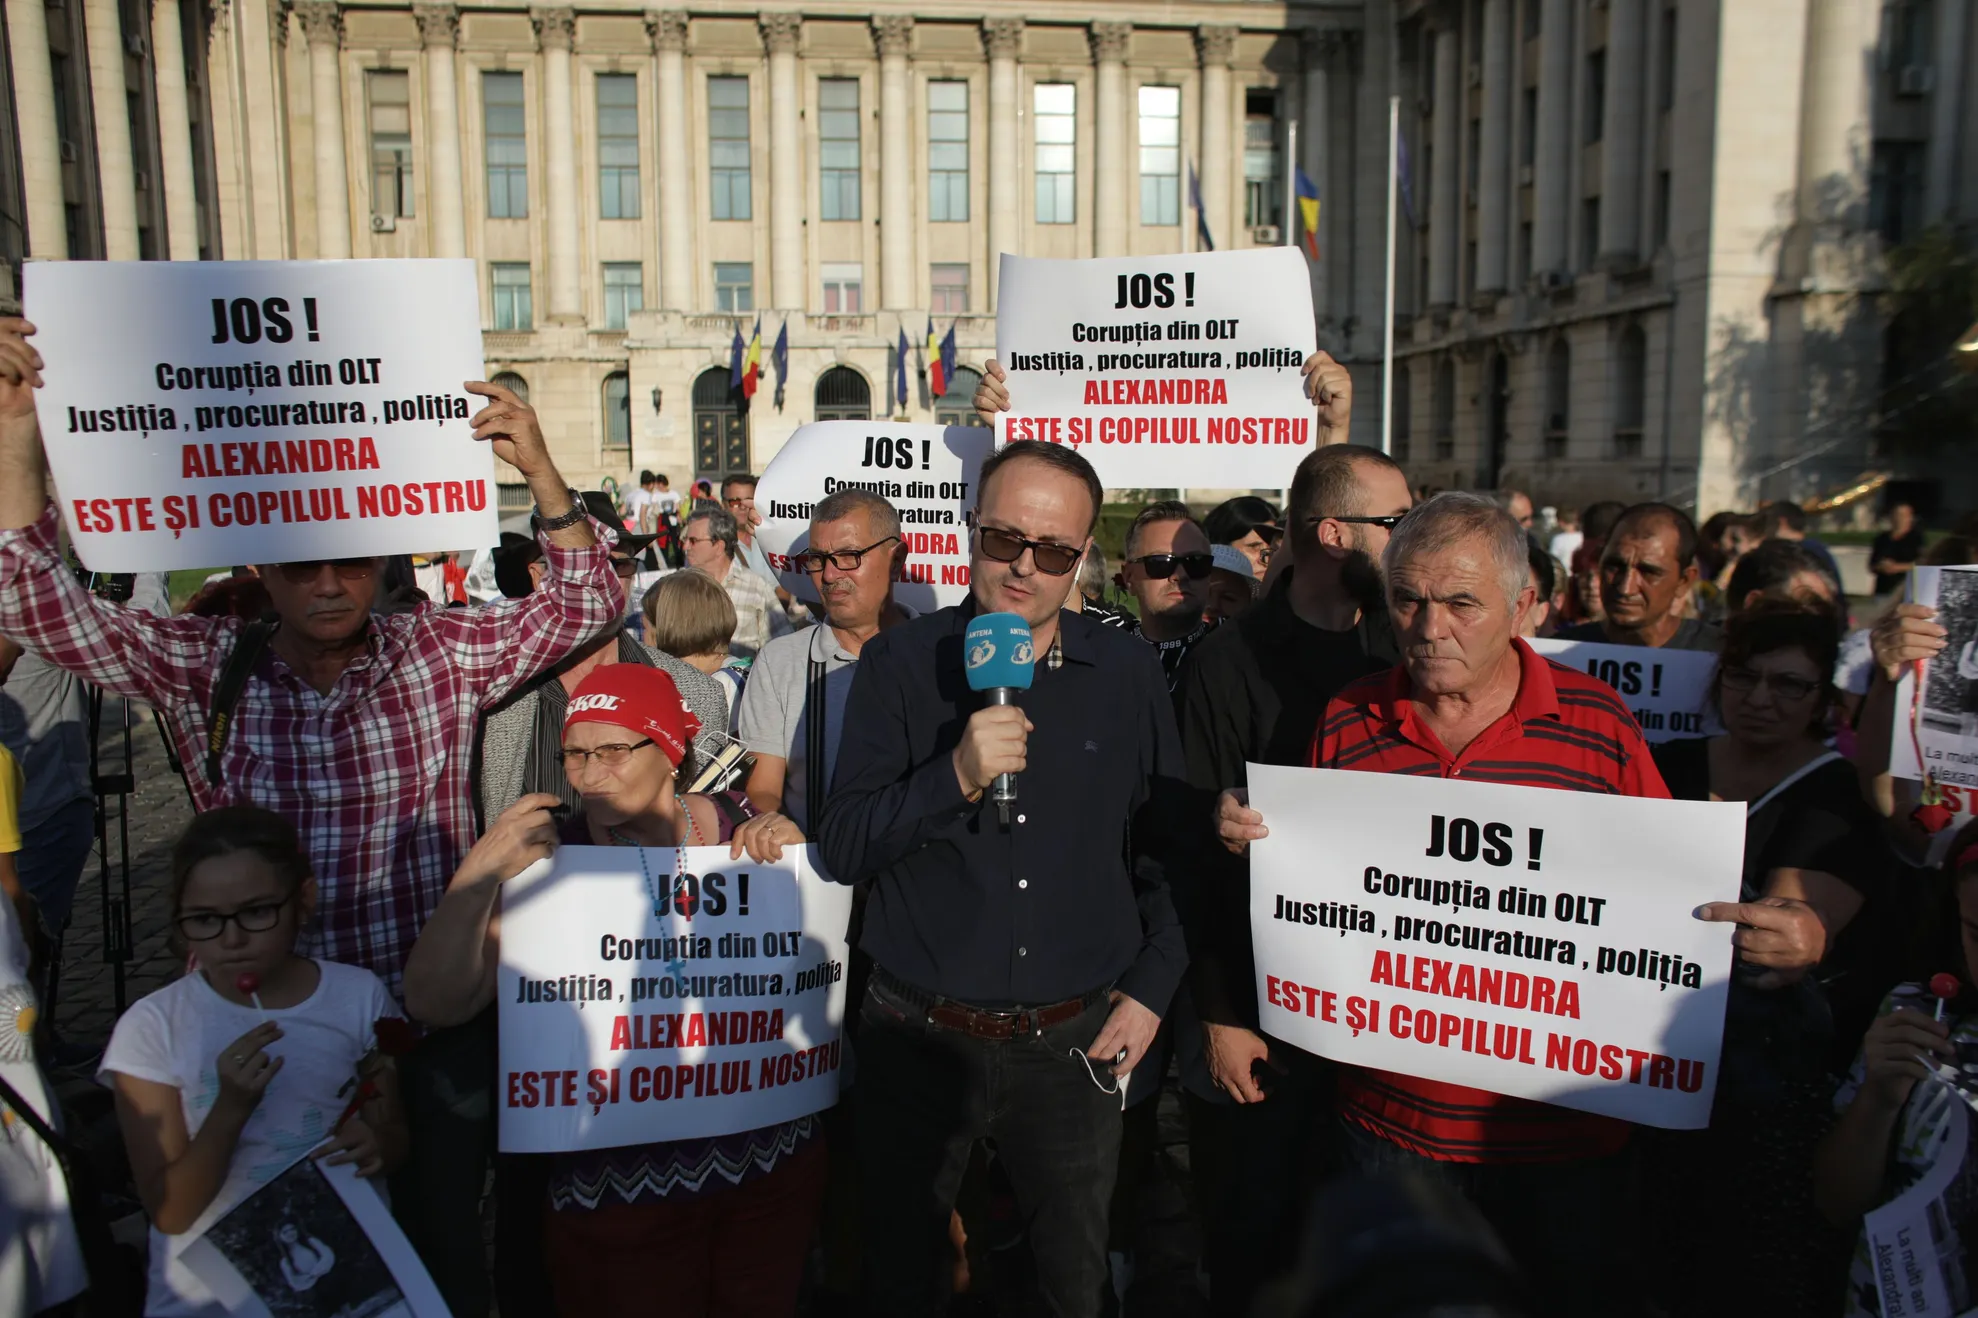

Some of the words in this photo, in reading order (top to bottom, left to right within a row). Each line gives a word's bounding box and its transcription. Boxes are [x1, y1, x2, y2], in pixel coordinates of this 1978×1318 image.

[1115, 272, 1175, 309] JOS
[1185, 272, 1195, 307] !
[211, 297, 293, 344] JOS
[304, 297, 320, 342] !
[1072, 322, 1161, 346] Corupția
[1167, 320, 1200, 340] din
[1205, 319, 1239, 339] OLT
[156, 361, 281, 396] Corupția
[288, 360, 332, 387] din
[340, 358, 382, 385] OLT
[1010, 352, 1084, 376] Justiția
[1098, 350, 1221, 372] procuratura
[1235, 348, 1302, 373] poliția
[1083, 378, 1228, 405] ALEXANDRA
[68, 404, 176, 439] Justiția
[197, 400, 365, 432] procuratura
[384, 394, 469, 427] poliția
[1005, 417, 1062, 443] ESTE
[1068, 417, 1093, 450] ȘI
[1099, 417, 1200, 445] COPILUL
[1207, 417, 1308, 446] NOSTRU
[182, 437, 380, 478] ALEXANDRA
[862, 436, 913, 469] JOS
[921, 440, 931, 470] !
[906, 481, 935, 499] din
[939, 482, 968, 499] OLT
[73, 498, 156, 533] ESTE
[164, 495, 199, 540] ȘI
[208, 487, 350, 528] COPILUL
[358, 479, 486, 518] NOSTRU
[768, 552, 812, 576] EST
[968, 629, 993, 639] ANTENA
[1010, 628, 1031, 637] ANTENA
[1159, 639, 1182, 650] 1999
[211, 712, 228, 753] Nikon
[1670, 711, 1703, 733] OLT
[1925, 746, 1942, 759] La
[1947, 752, 1978, 766] mult
[1928, 765, 1978, 784] Alexan
[1425, 815, 1512, 867] JOS
[1527, 828, 1544, 871] !
[654, 872, 727, 917] JOS
[738, 873, 749, 916] !
[1364, 866, 1489, 914] Corupția
[1498, 885, 1547, 919] din
[1554, 893, 1606, 927] OLT
[718, 933, 756, 959] din
[762, 931, 802, 957] OLT
[1273, 894, 1376, 938] Justiția
[1394, 915, 1575, 966] procuratura
[1597, 945, 1702, 992] poliția
[516, 974, 612, 1009] Justiția
[631, 972, 782, 1003] procuratura
[795, 959, 842, 995] poliția
[1370, 950, 1581, 1019] ALEXANDRA
[610, 1008, 784, 1051] ALEXANDRA
[1266, 975, 1338, 1024] ESTE
[1346, 995, 1379, 1038] ȘI
[1389, 1003, 1536, 1065] COPILUL
[1545, 1033, 1705, 1093] NOSTRU
[507, 1070, 578, 1108] ESTE
[587, 1068, 620, 1116] ȘI
[629, 1060, 752, 1102] COPILUL
[758, 1038, 840, 1090] NOSTRU
[1896, 1225, 1911, 1247] La
[1911, 1289, 1931, 1314] ani
